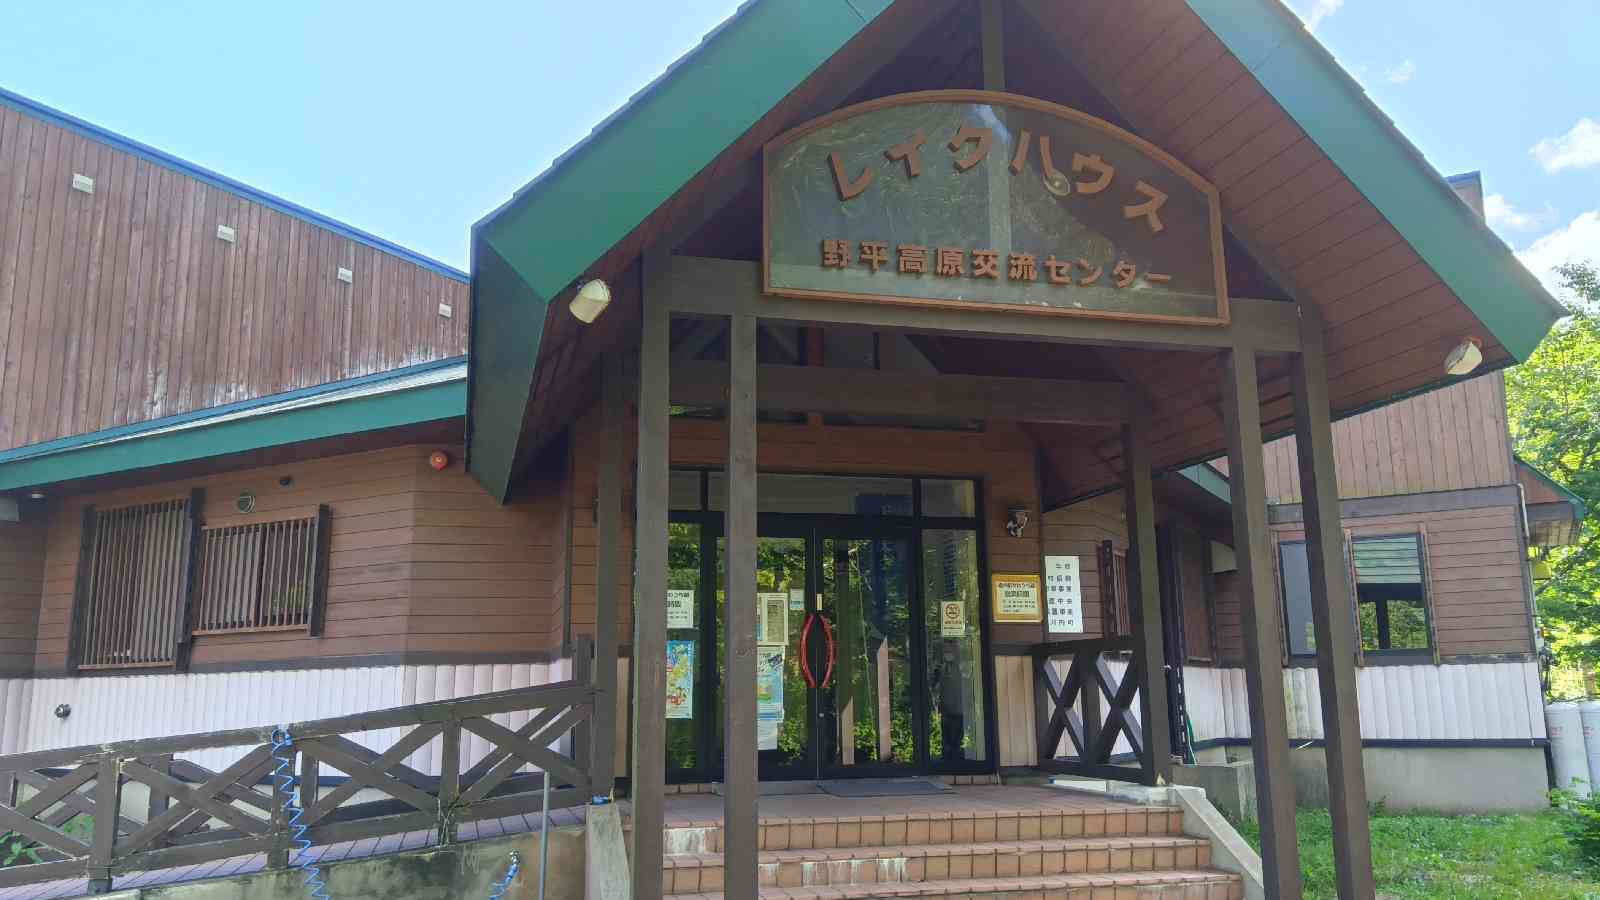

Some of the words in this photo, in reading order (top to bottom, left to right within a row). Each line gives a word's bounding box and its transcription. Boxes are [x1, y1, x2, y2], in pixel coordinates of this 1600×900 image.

[828, 125, 1169, 233] レイクハウス
[820, 238, 1172, 288] 野平高原交流センター
